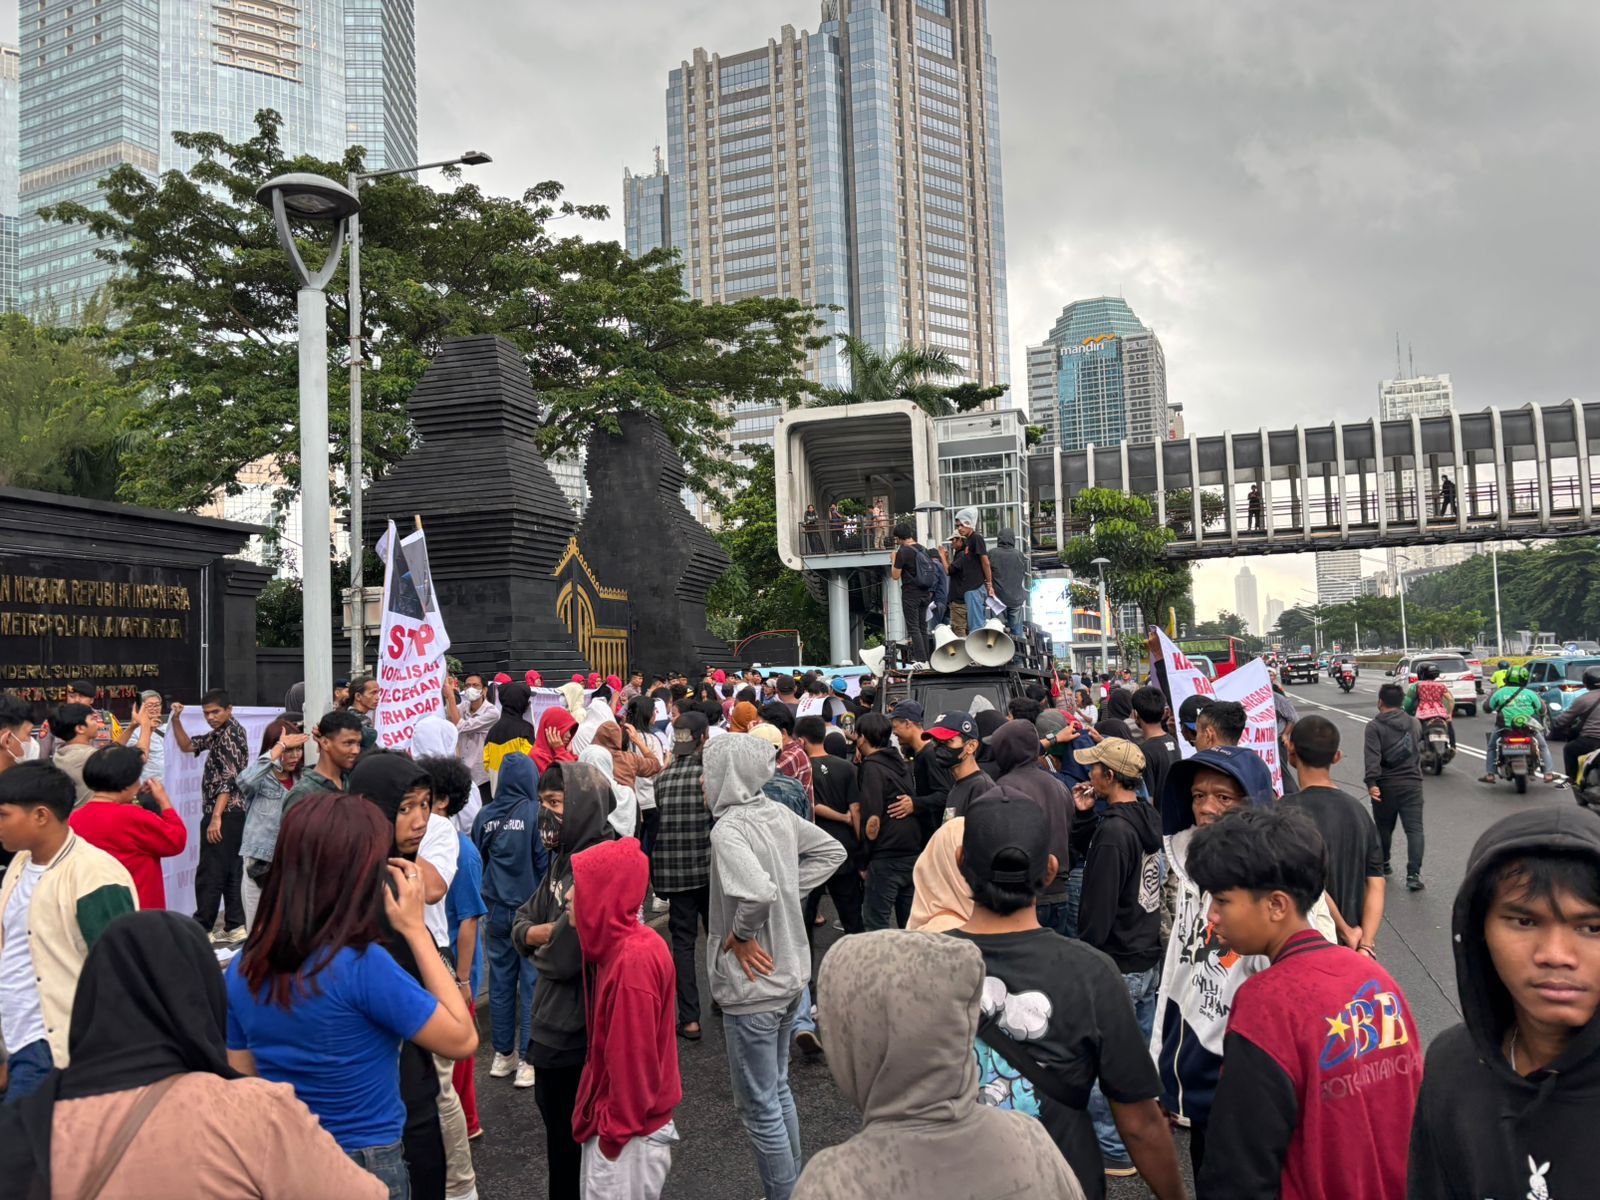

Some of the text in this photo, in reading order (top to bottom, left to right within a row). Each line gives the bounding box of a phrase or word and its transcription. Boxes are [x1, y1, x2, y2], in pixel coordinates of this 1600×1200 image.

[1060, 341, 1105, 356] mandiri
[15, 576, 69, 604] NEGARA
[71, 580, 130, 608] REPUBLIK
[133, 584, 190, 611] INDONESIA
[53, 664, 118, 678] SUDIRMAN
